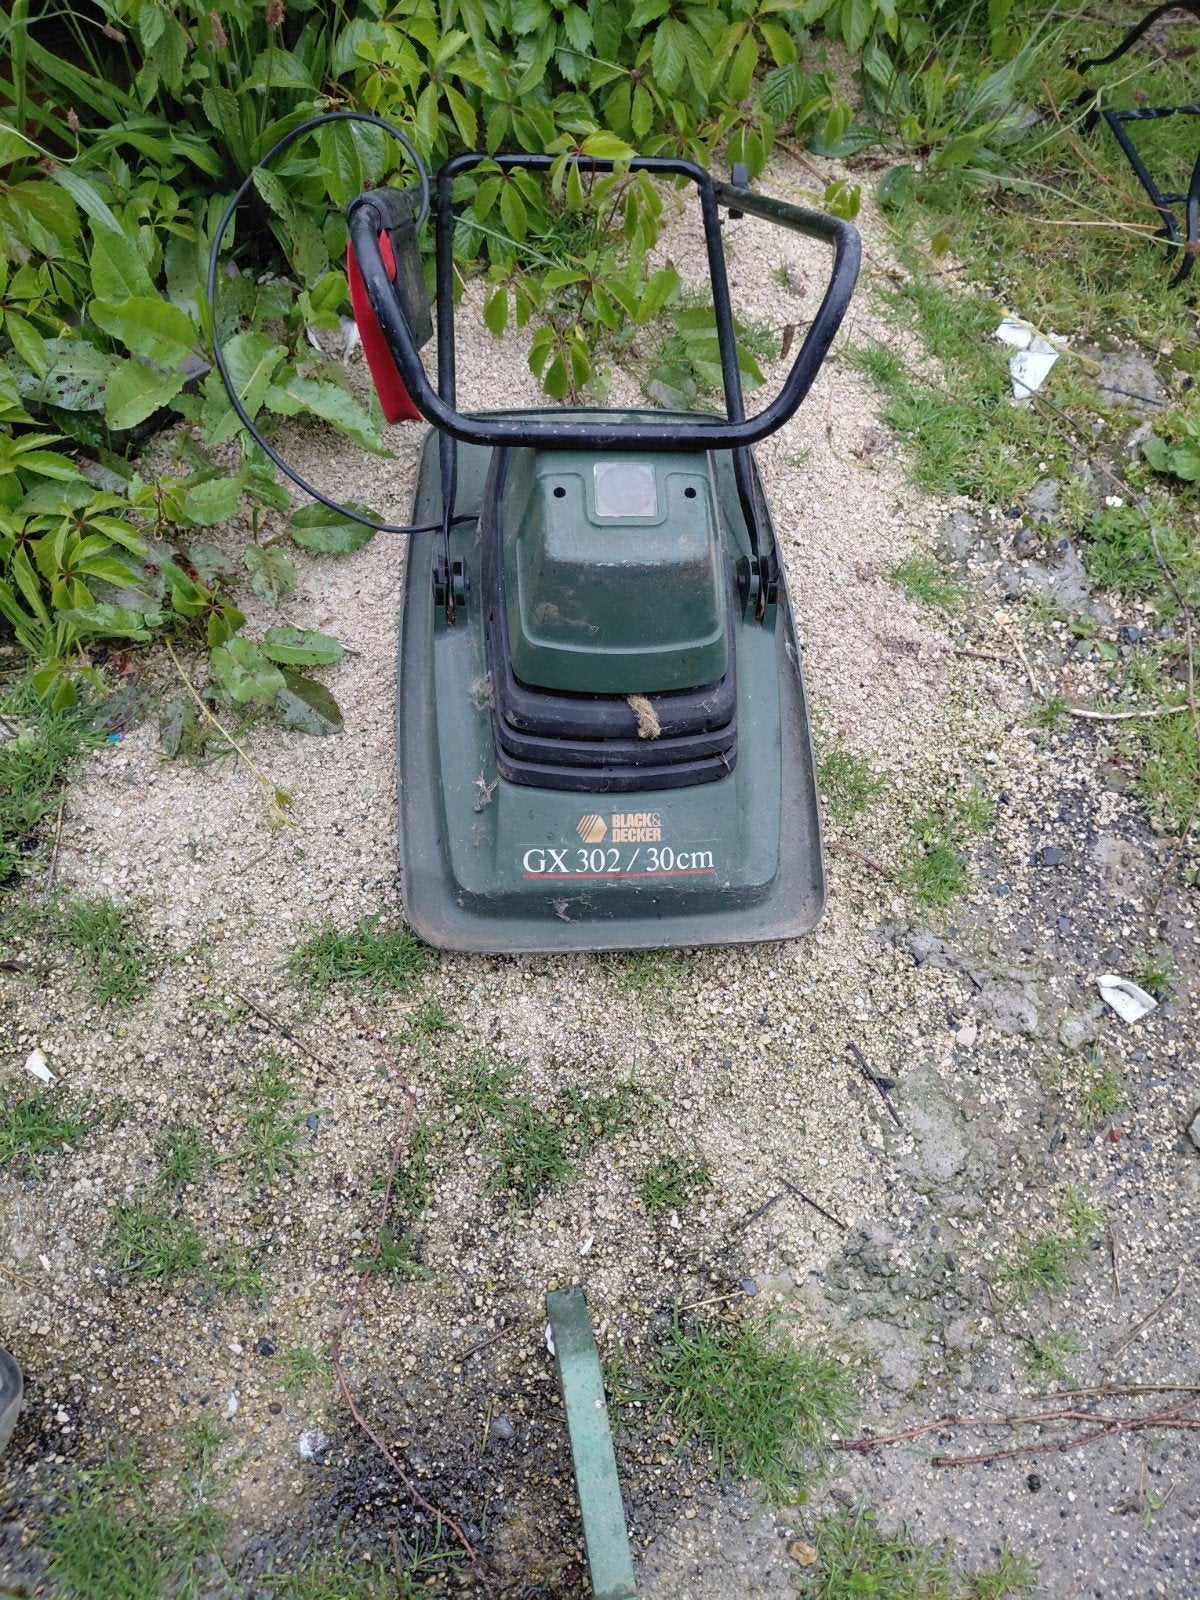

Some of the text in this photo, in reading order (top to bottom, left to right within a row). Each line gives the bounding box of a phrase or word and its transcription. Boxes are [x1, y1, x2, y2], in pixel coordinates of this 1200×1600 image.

[612, 828, 662, 843] DECKER
[522, 849, 570, 873] GX
[575, 848, 621, 873] 302
[646, 847, 714, 871] 30cm
